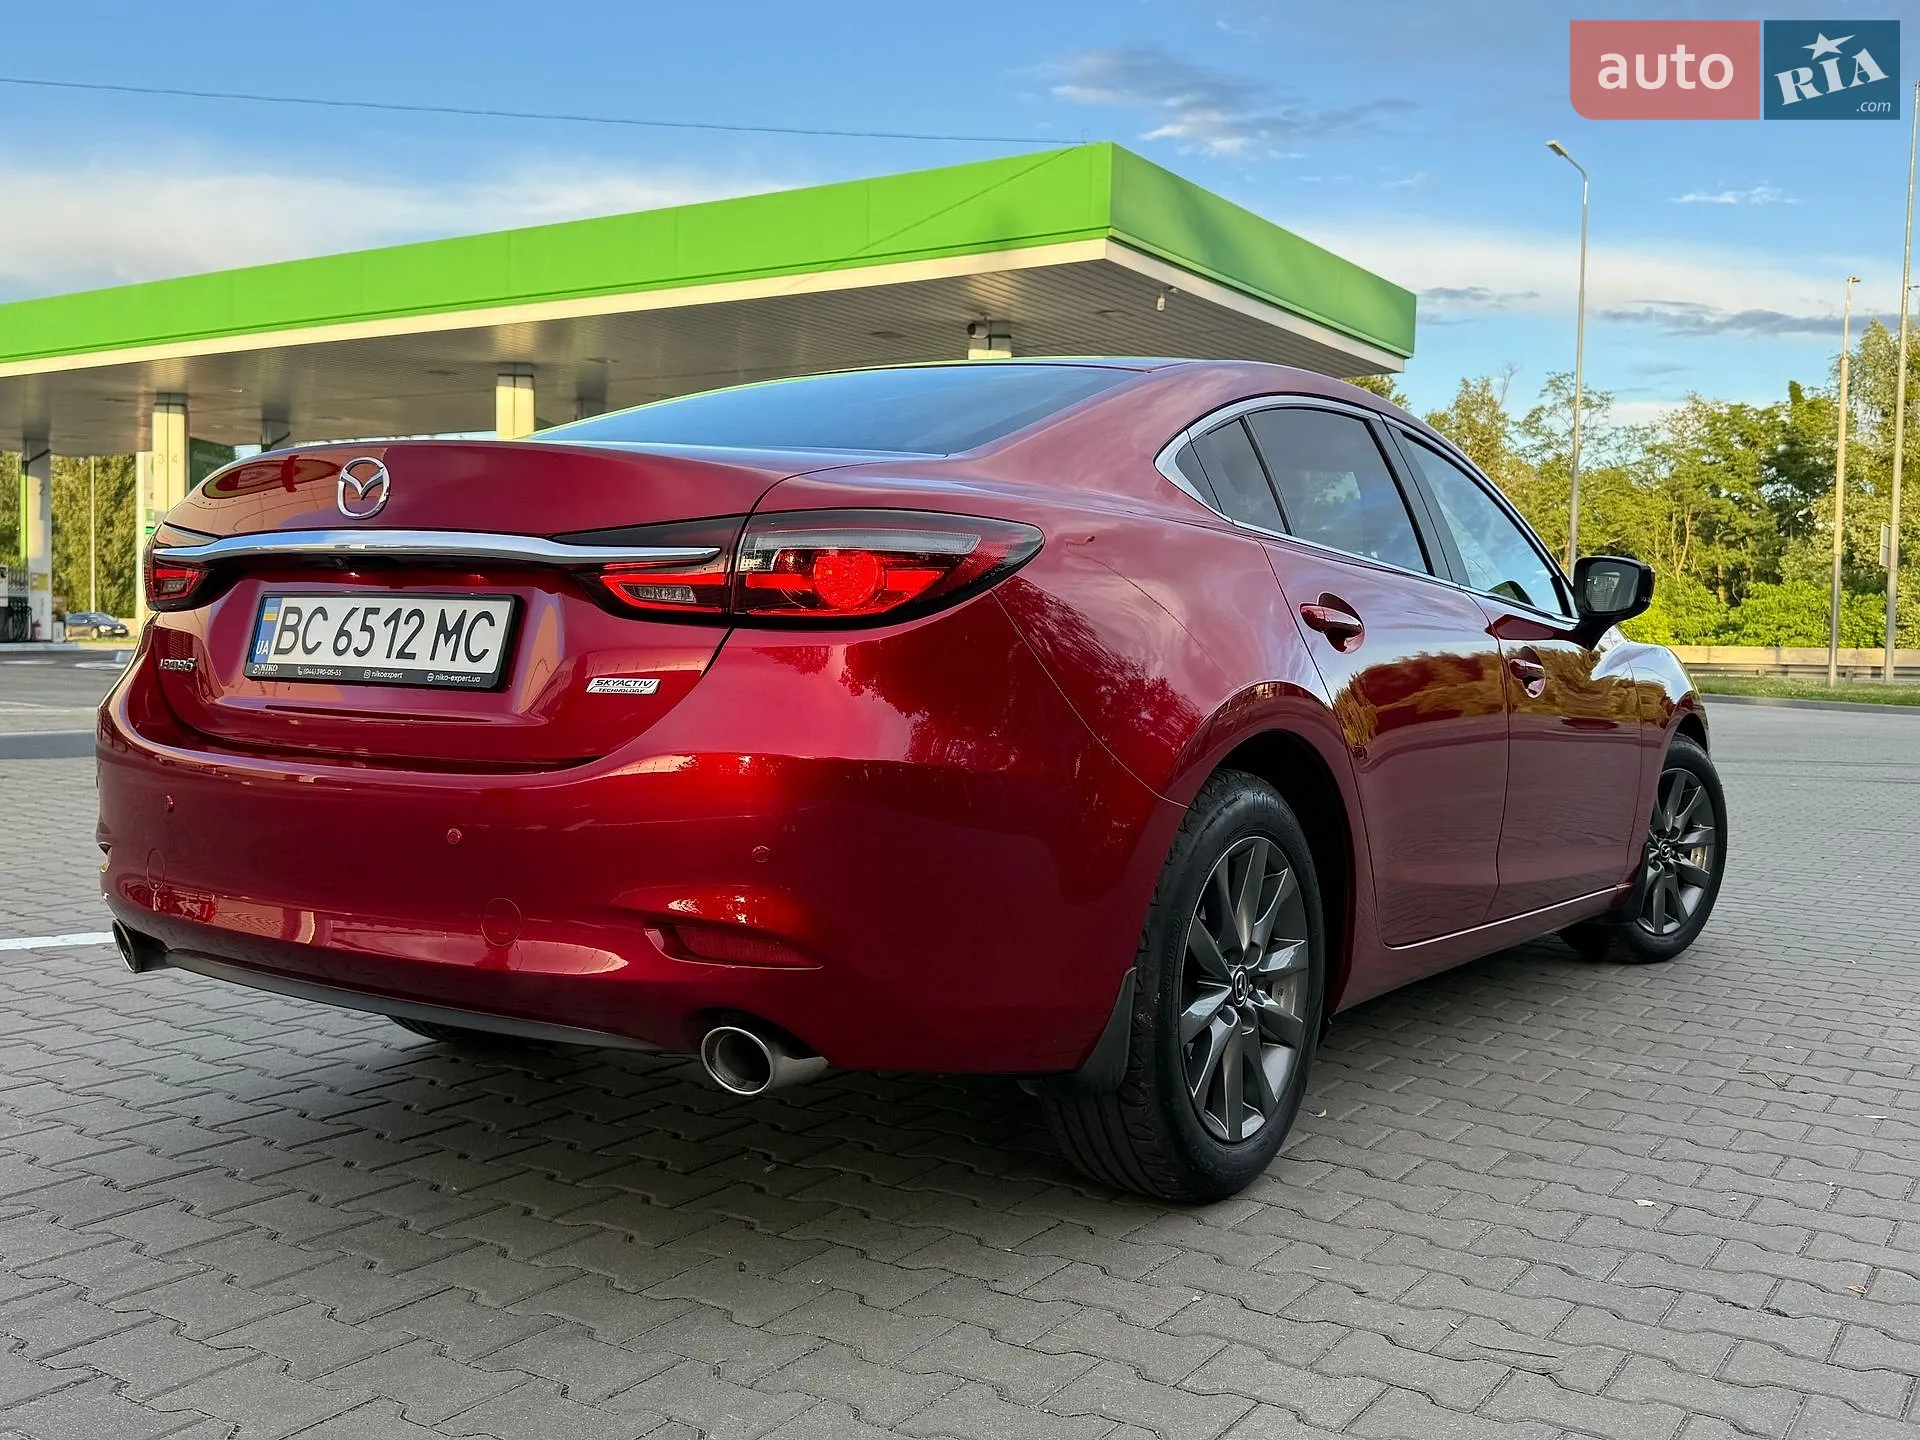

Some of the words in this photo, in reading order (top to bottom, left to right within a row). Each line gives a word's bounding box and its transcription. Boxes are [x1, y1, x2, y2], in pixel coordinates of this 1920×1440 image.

[273, 605, 329, 656] BC
[332, 605, 425, 661] 6512
[428, 608, 496, 664] MC
[255, 640, 270, 656] UA
[260, 663, 279, 672] NIKO
[371, 670, 404, 680] nikoexpert
[434, 673, 481, 684] niko-expert.ua
